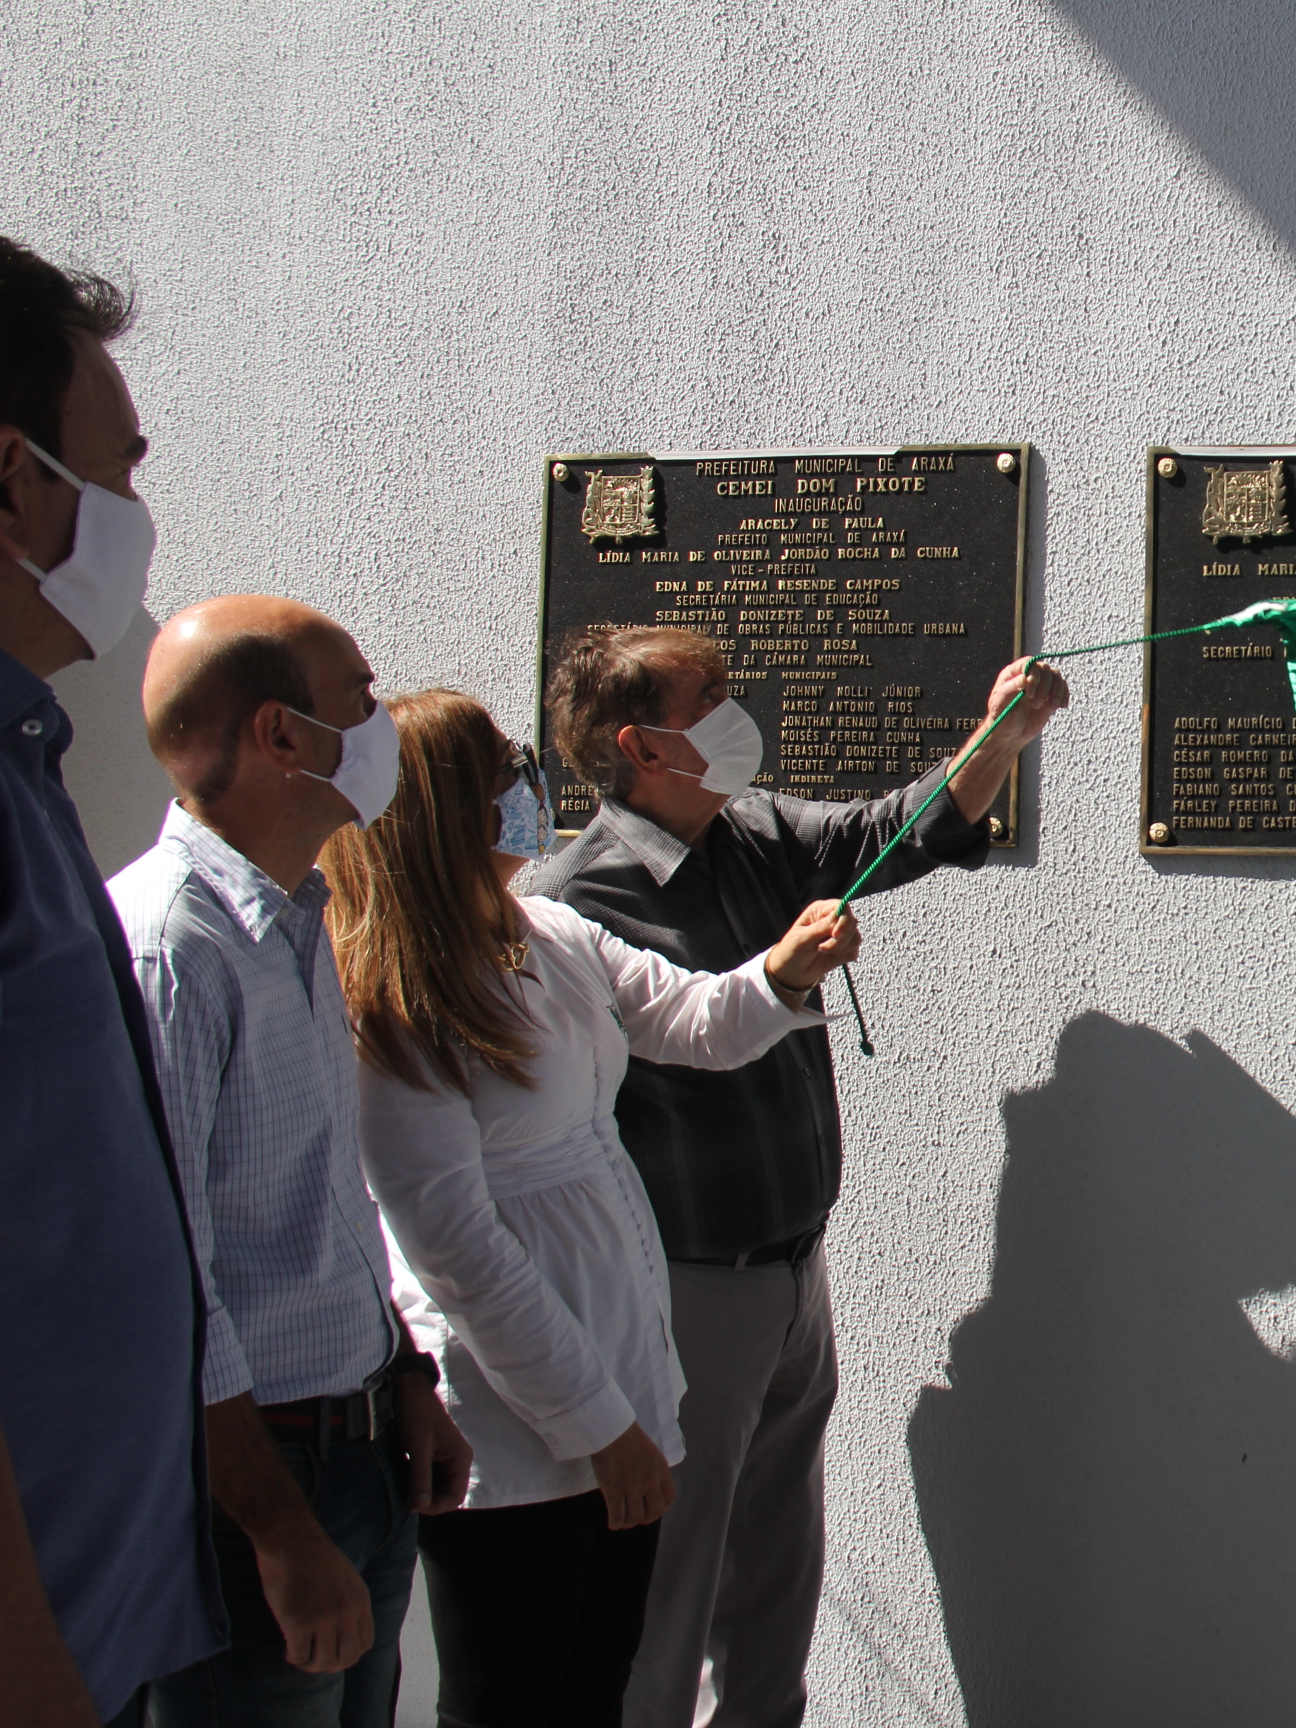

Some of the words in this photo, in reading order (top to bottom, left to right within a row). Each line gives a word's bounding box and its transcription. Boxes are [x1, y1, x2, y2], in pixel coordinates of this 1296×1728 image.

[697, 461, 775, 475] PREFEITURA
[795, 459, 862, 473] MUNICIPAL
[879, 458, 895, 471] DE
[912, 453, 955, 471] ARAXÁ
[717, 481, 773, 495] CEMEI
[797, 479, 835, 493] DOM
[857, 477, 926, 491] PIXOTE
[775, 495, 862, 514] INAUGURAÇÃO
[740, 519, 798, 530] ARACELY
[813, 518, 829, 529] DE
[845, 517, 884, 528] PAULA
[719, 534, 767, 545] PREFEITO
[781, 533, 835, 543] MUNICIPAL
[848, 532, 860, 543] DE
[872, 529, 905, 542] ARAXÁ
[599, 551, 631, 563] LÍDIA
[642, 552, 680, 562] MARIA
[689, 551, 706, 561] DE
[714, 550, 771, 560] OLIVEIRA
[781, 546, 829, 560] JORDÃO
[838, 548, 880, 559] ROCHA
[891, 548, 906, 559] DA
[917, 547, 960, 558] CUNHA
[1203, 563, 1241, 576] LÍDIA
[656, 582, 687, 592] EDNA
[698, 581, 714, 591] DE
[724, 578, 768, 591] FÁTIMA
[779, 580, 837, 590] RESENDE
[846, 579, 900, 590] CAMPOS
[676, 592, 737, 605] SECRETÁRIA
[745, 595, 797, 605] MUNICIPAL
[805, 594, 817, 604] DE
[826, 591, 878, 607] EDUCAÇÃO
[656, 608, 726, 621] SEBASTIÃO
[740, 610, 804, 621] DONIZETE
[817, 610, 834, 620] DE
[849, 610, 890, 620] SOUZA
[717, 624, 730, 634] DE
[738, 624, 771, 634] OBRAS
[779, 620, 829, 634] PÚBLICAS
[837, 624, 844, 634] E
[853, 624, 915, 634] MOBILIDADE
[924, 623, 965, 634] URBANA
[751, 640, 809, 650] ROBERTO
[824, 639, 858, 650] ROSA
[1202, 642, 1272, 658] SECRETÁRIO
[744, 655, 756, 665] DA
[765, 652, 806, 665] CÂMARA
[817, 655, 872, 666] MUNICIPAL
[728, 670, 768, 679] ETÁRIOS
[726, 686, 746, 696] UZA
[784, 686, 824, 696] JOHNNY
[882, 684, 921, 697] JÚNIOR
[783, 701, 818, 711] MARCO
[888, 702, 913, 713] RIOS
[782, 716, 832, 727] JONATHAN
[839, 717, 878, 728] RENAUD
[885, 718, 897, 728] DE
[904, 718, 950, 729] OLIVEIRA
[1174, 717, 1218, 729] ADOLFO
[1228, 715, 1283, 729] MAURÍCIO
[782, 727, 819, 741] MOISÉS
[831, 731, 875, 742] PEREIRA
[887, 732, 921, 743] CUNHA
[1174, 733, 1240, 746] ALEXANDRE
[781, 743, 837, 755] SEBASTIÃO
[847, 746, 899, 757] DONIZETE
[908, 747, 920, 758] DE
[930, 748, 957, 758] SOUZ
[1173, 748, 1211, 762] CÉSAR
[1221, 750, 1268, 762] ROMERO
[1280, 751, 1294, 762] DA
[781, 760, 826, 770] VICENTE
[838, 761, 875, 771] AIRTON
[887, 762, 899, 772] DE
[791, 775, 835, 783] INDIRETA
[1173, 767, 1211, 779] EDSON
[1224, 767, 1267, 779] GASPAR
[1279, 767, 1294, 779] DE
[562, 785, 594, 796] ANDRÉ
[827, 790, 871, 800] JUSTINO
[1173, 783, 1220, 796] FABIANO
[1231, 783, 1274, 795] SANTOS
[562, 797, 590, 810] RÉGIA
[1172, 797, 1217, 812] FÁRLEY
[1229, 800, 1278, 812] PEREIRA
[1172, 816, 1231, 829] FERNANDA
[1239, 817, 1254, 829] DE
